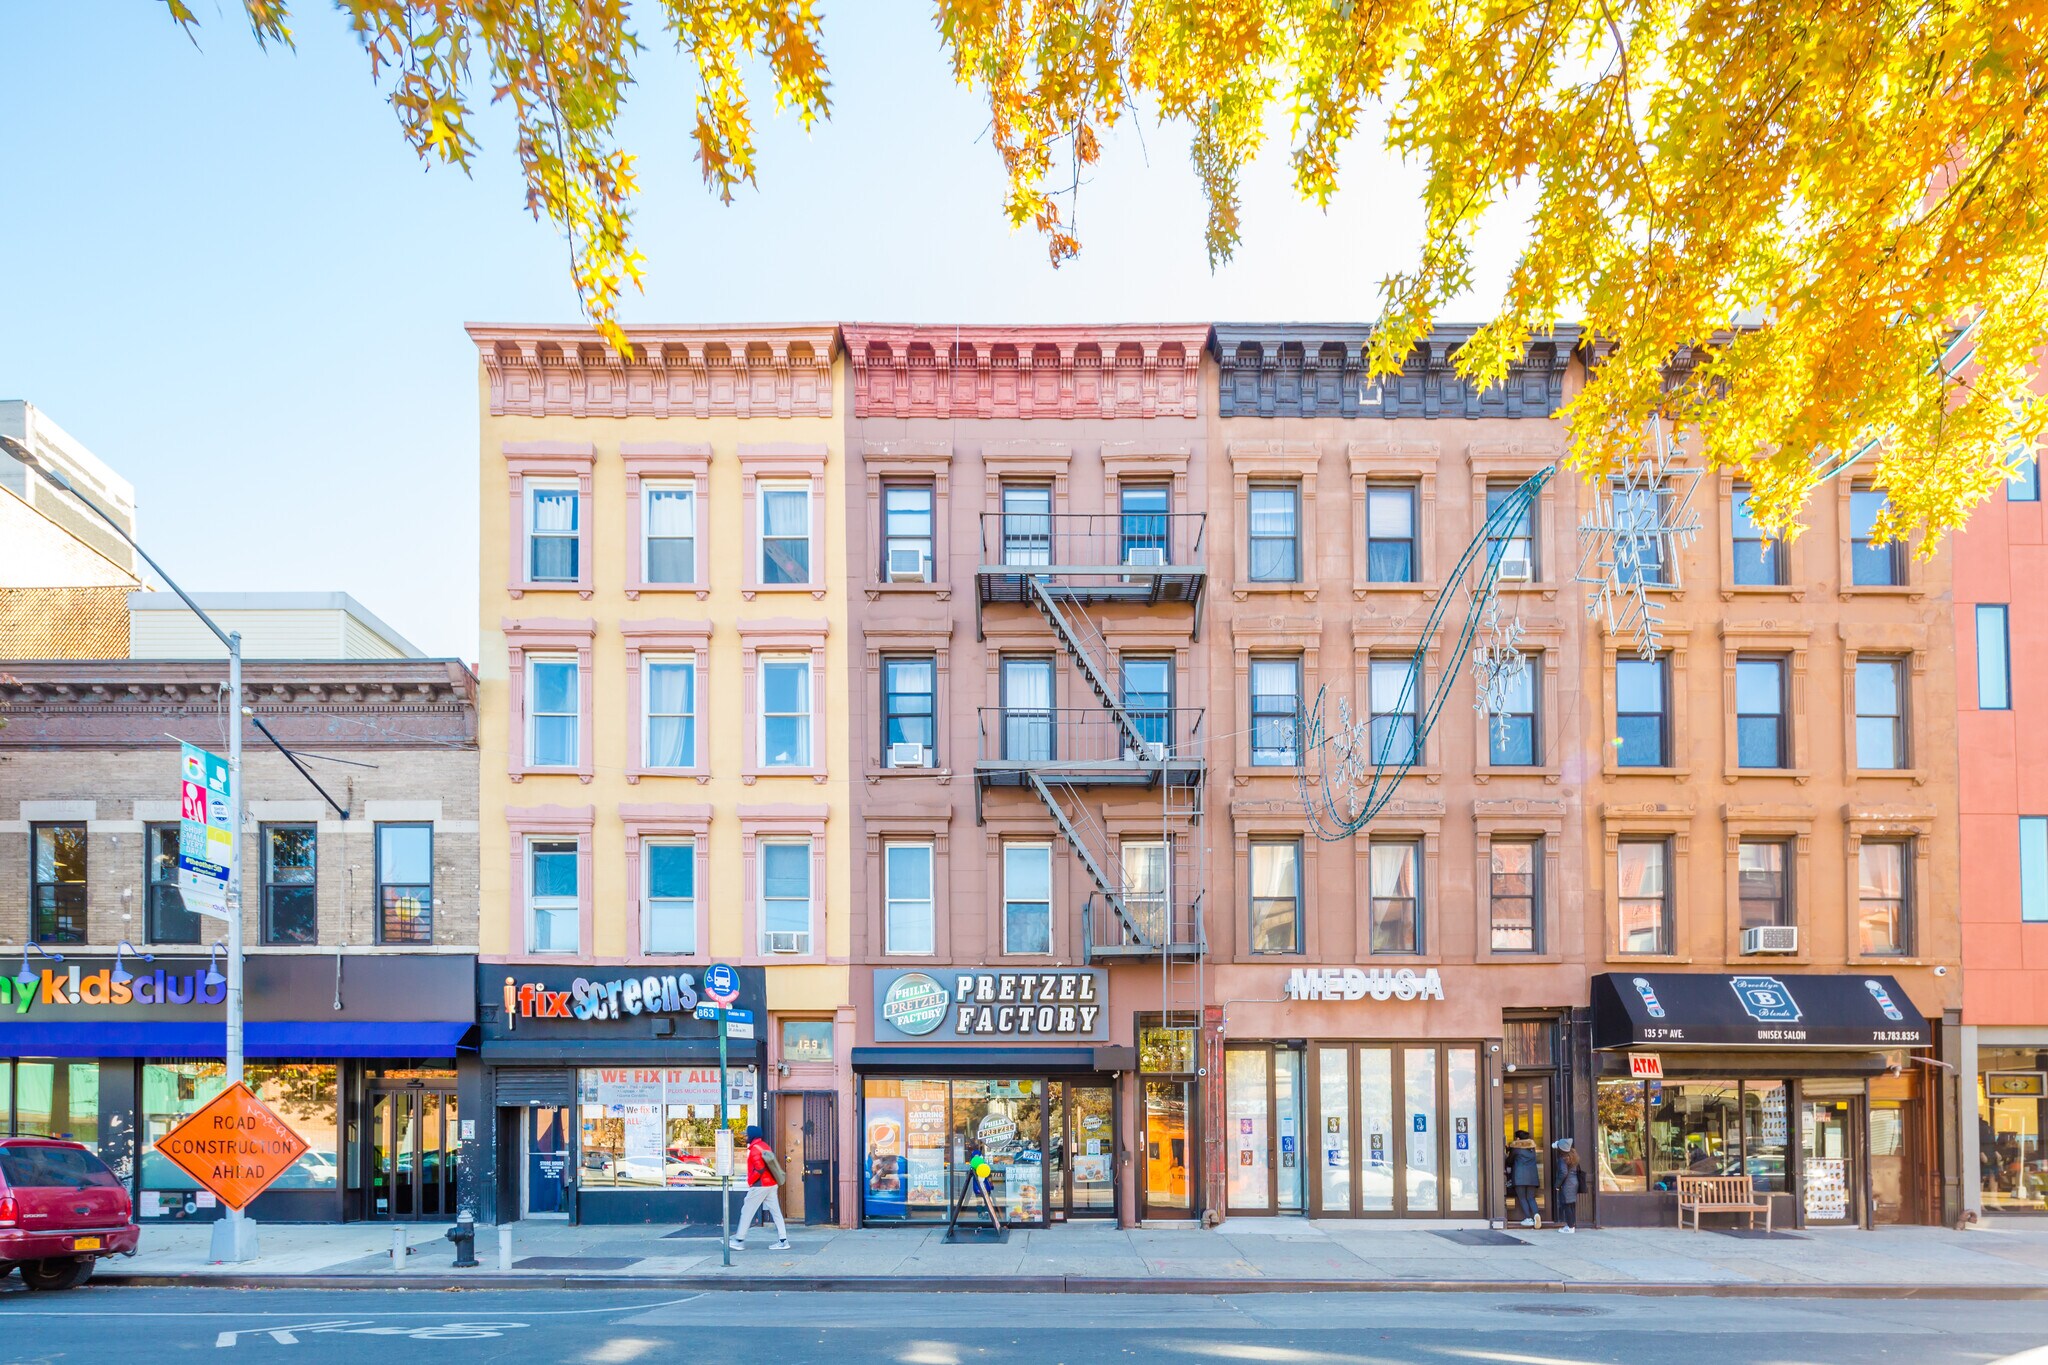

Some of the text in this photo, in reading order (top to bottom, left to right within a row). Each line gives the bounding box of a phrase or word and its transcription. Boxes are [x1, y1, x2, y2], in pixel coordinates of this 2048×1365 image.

[184, 824, 203, 834] SHOP
[181, 830, 203, 842] SMALL
[182, 838, 203, 849] EVERY
[186, 846, 199, 855] DAY
[956, 974, 1095, 1001] PRETZEL
[1291, 968, 1444, 1000] MEDUSA
[1737, 980, 1779, 989] Brooklyn
[572, 973, 698, 1020] Screens
[895, 983, 931, 999] PHILLY
[890, 994, 943, 1014] PRETZEL
[1754, 992, 1776, 1005] B
[698, 1008, 714, 1018] B63
[897, 1007, 942, 1026] FACTORY
[1759, 1008, 1790, 1016] Blends
[956, 1006, 1098, 1032] FACTORY
[1644, 1029, 1656, 1038] 135
[1669, 1029, 1685, 1038] AVE.
[1757, 1030, 1806, 1040] UNISEX SALON
[1872, 1031, 1920, 1041] 718.783.8354
[799, 1040, 818, 1049] 129
[1633, 1058, 1660, 1073] ATM
[601, 1070, 627, 1083] WE
[634, 1070, 661, 1083] FIX
[667, 1070, 682, 1083] IT
[213, 1116, 256, 1130] ROAD
[984, 1118, 1006, 1128] PHILLY
[982, 1125, 1012, 1137] PRETZEL
[171, 1140, 291, 1155] CONSTRUCTION
[1024, 1152, 1041, 1160] OPEN
[212, 1165, 265, 1179] AHEAD
